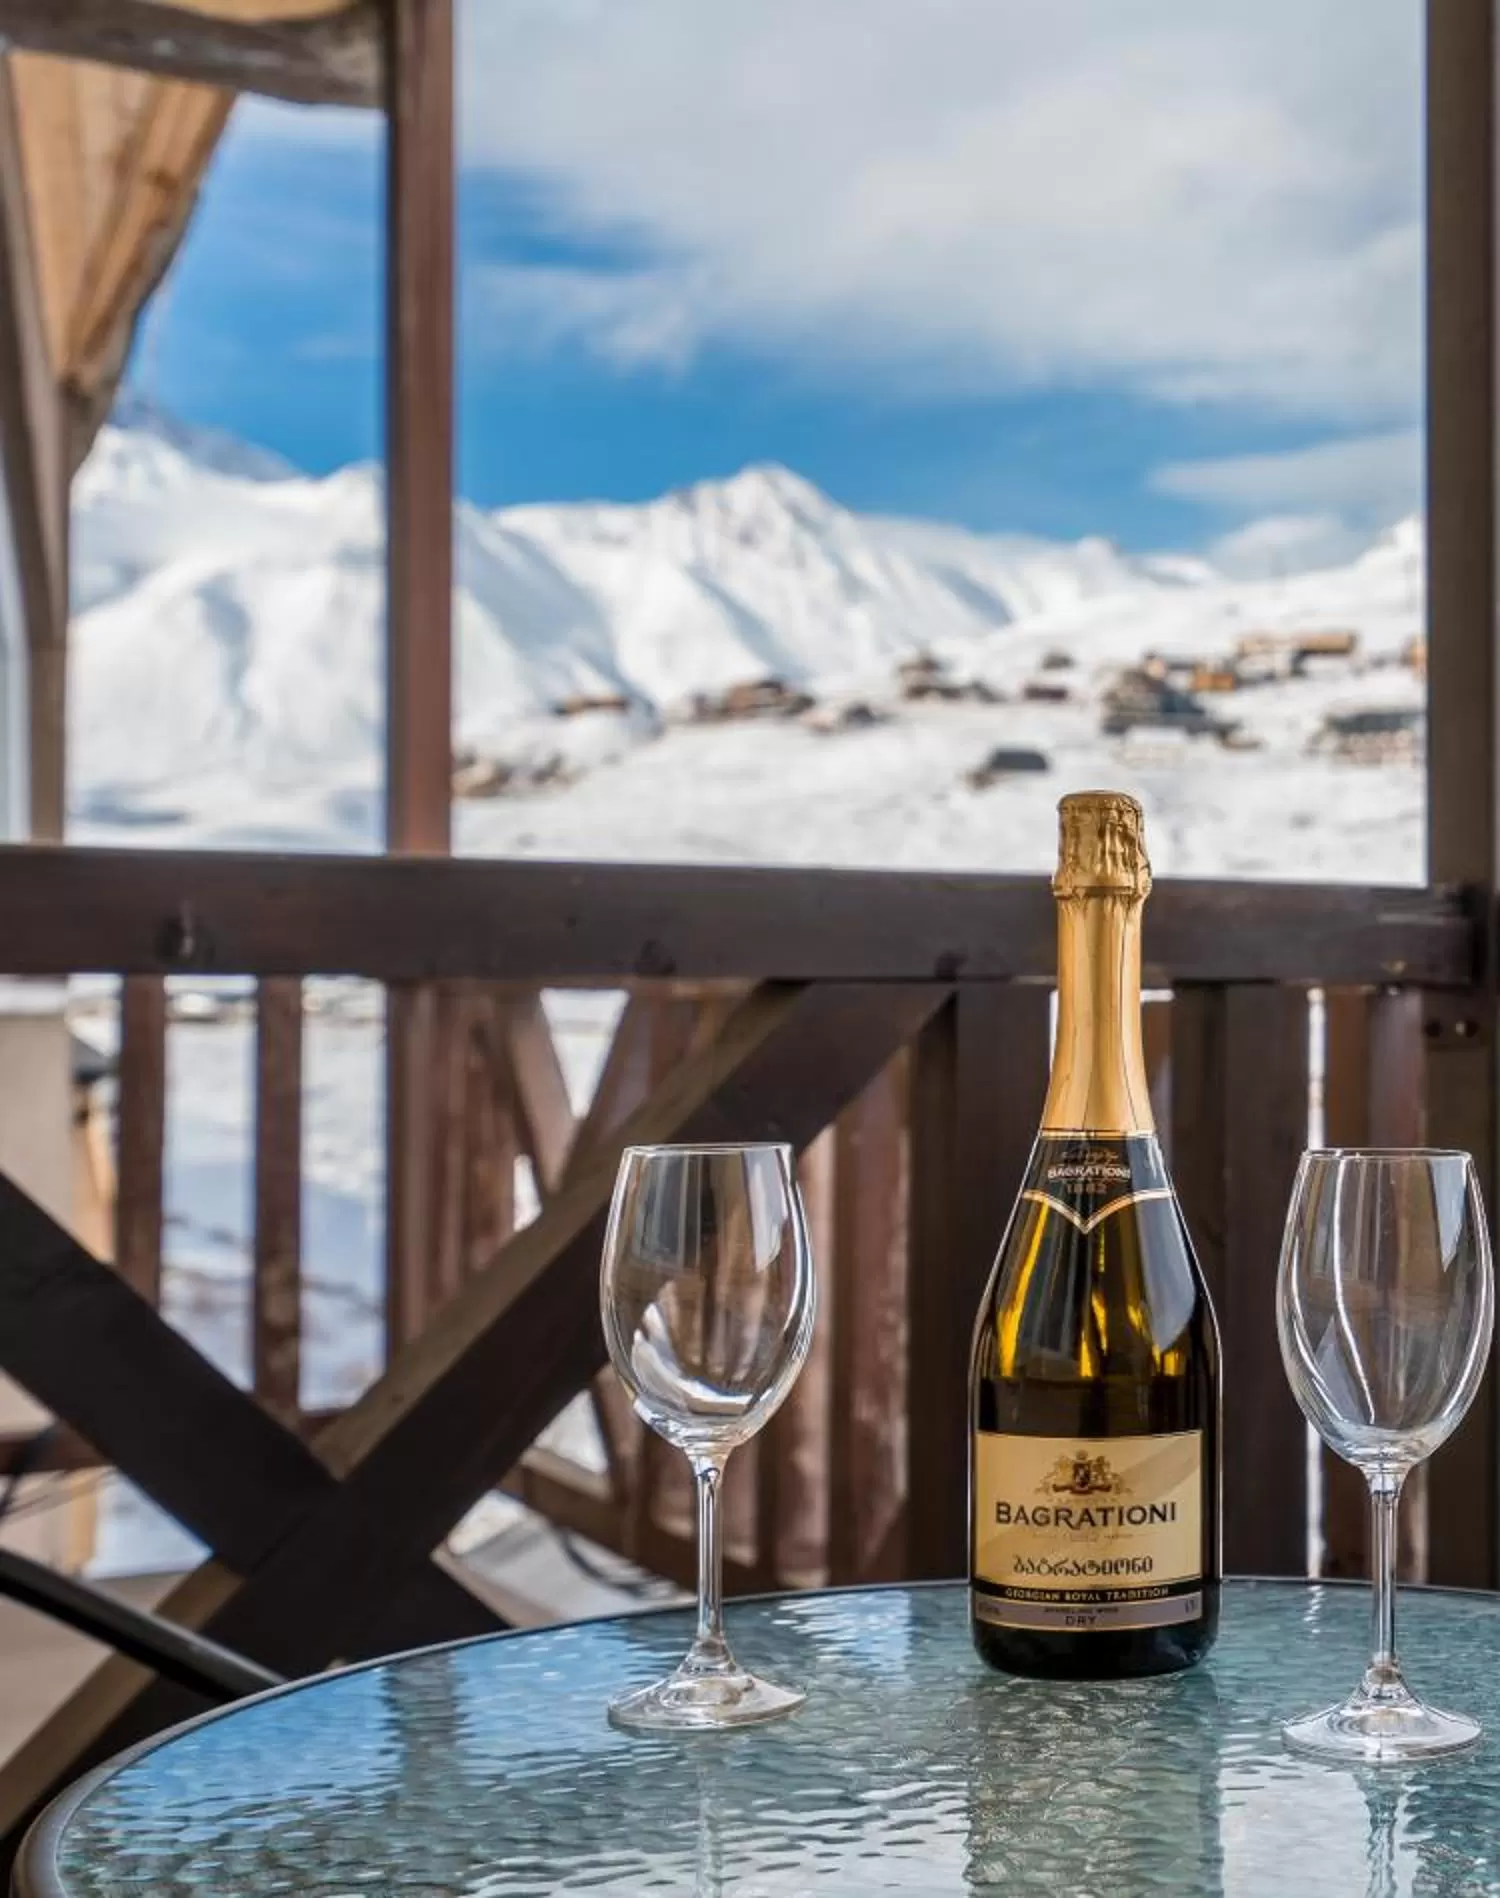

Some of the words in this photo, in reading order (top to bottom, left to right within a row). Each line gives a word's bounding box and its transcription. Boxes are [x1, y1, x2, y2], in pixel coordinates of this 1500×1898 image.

[1048, 1166, 1131, 1179] BAGRATIONI
[996, 1501, 1177, 1530] BAGRATIONI
[1013, 1554, 1153, 1578] ბაგრატიონი
[1005, 1587, 1059, 1601] GEORGIAN
[1064, 1591, 1101, 1601] ROYAL
[1106, 1586, 1169, 1601] TRADITION
[1065, 1615, 1097, 1626] DRY
